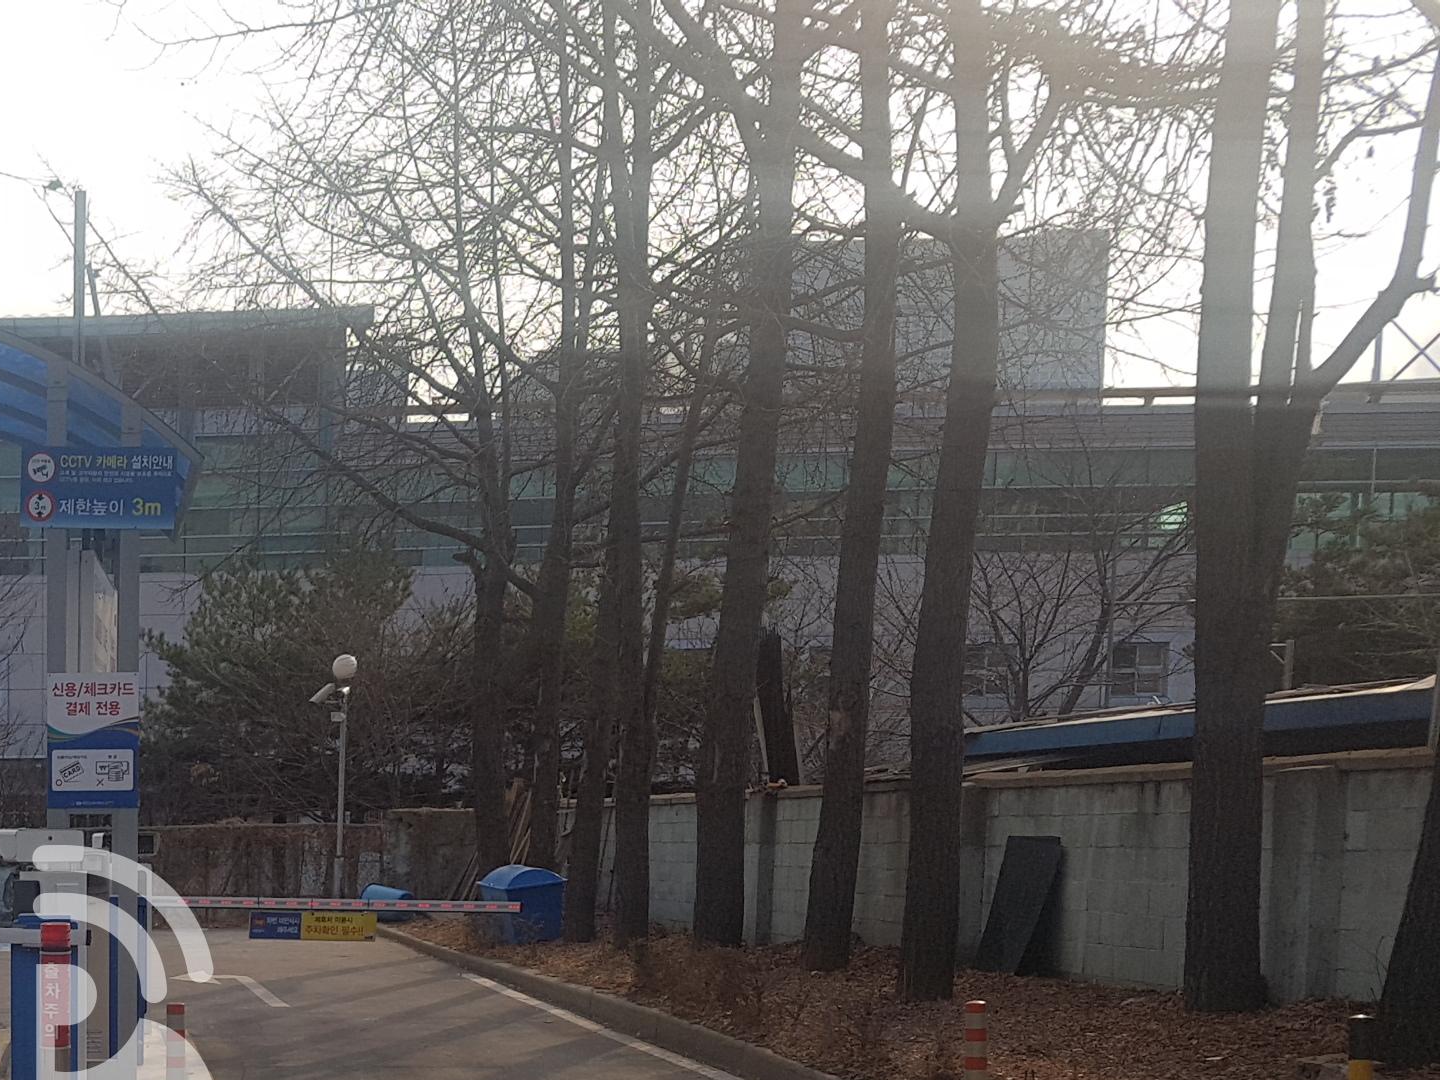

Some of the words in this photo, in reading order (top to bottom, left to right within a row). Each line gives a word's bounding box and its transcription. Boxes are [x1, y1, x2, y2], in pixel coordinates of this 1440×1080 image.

[60, 455, 92, 469] CCTV
[95, 455, 128, 470] 카메라
[131, 455, 173, 471] 설치안내
[59, 498, 124, 517] 제한높이
[131, 498, 162, 516] 3m
[52, 682, 135, 698] 신용/체크카드
[65, 701, 91, 717] 결제
[95, 701, 121, 717] 전용
[62, 765, 81, 779] CARD
